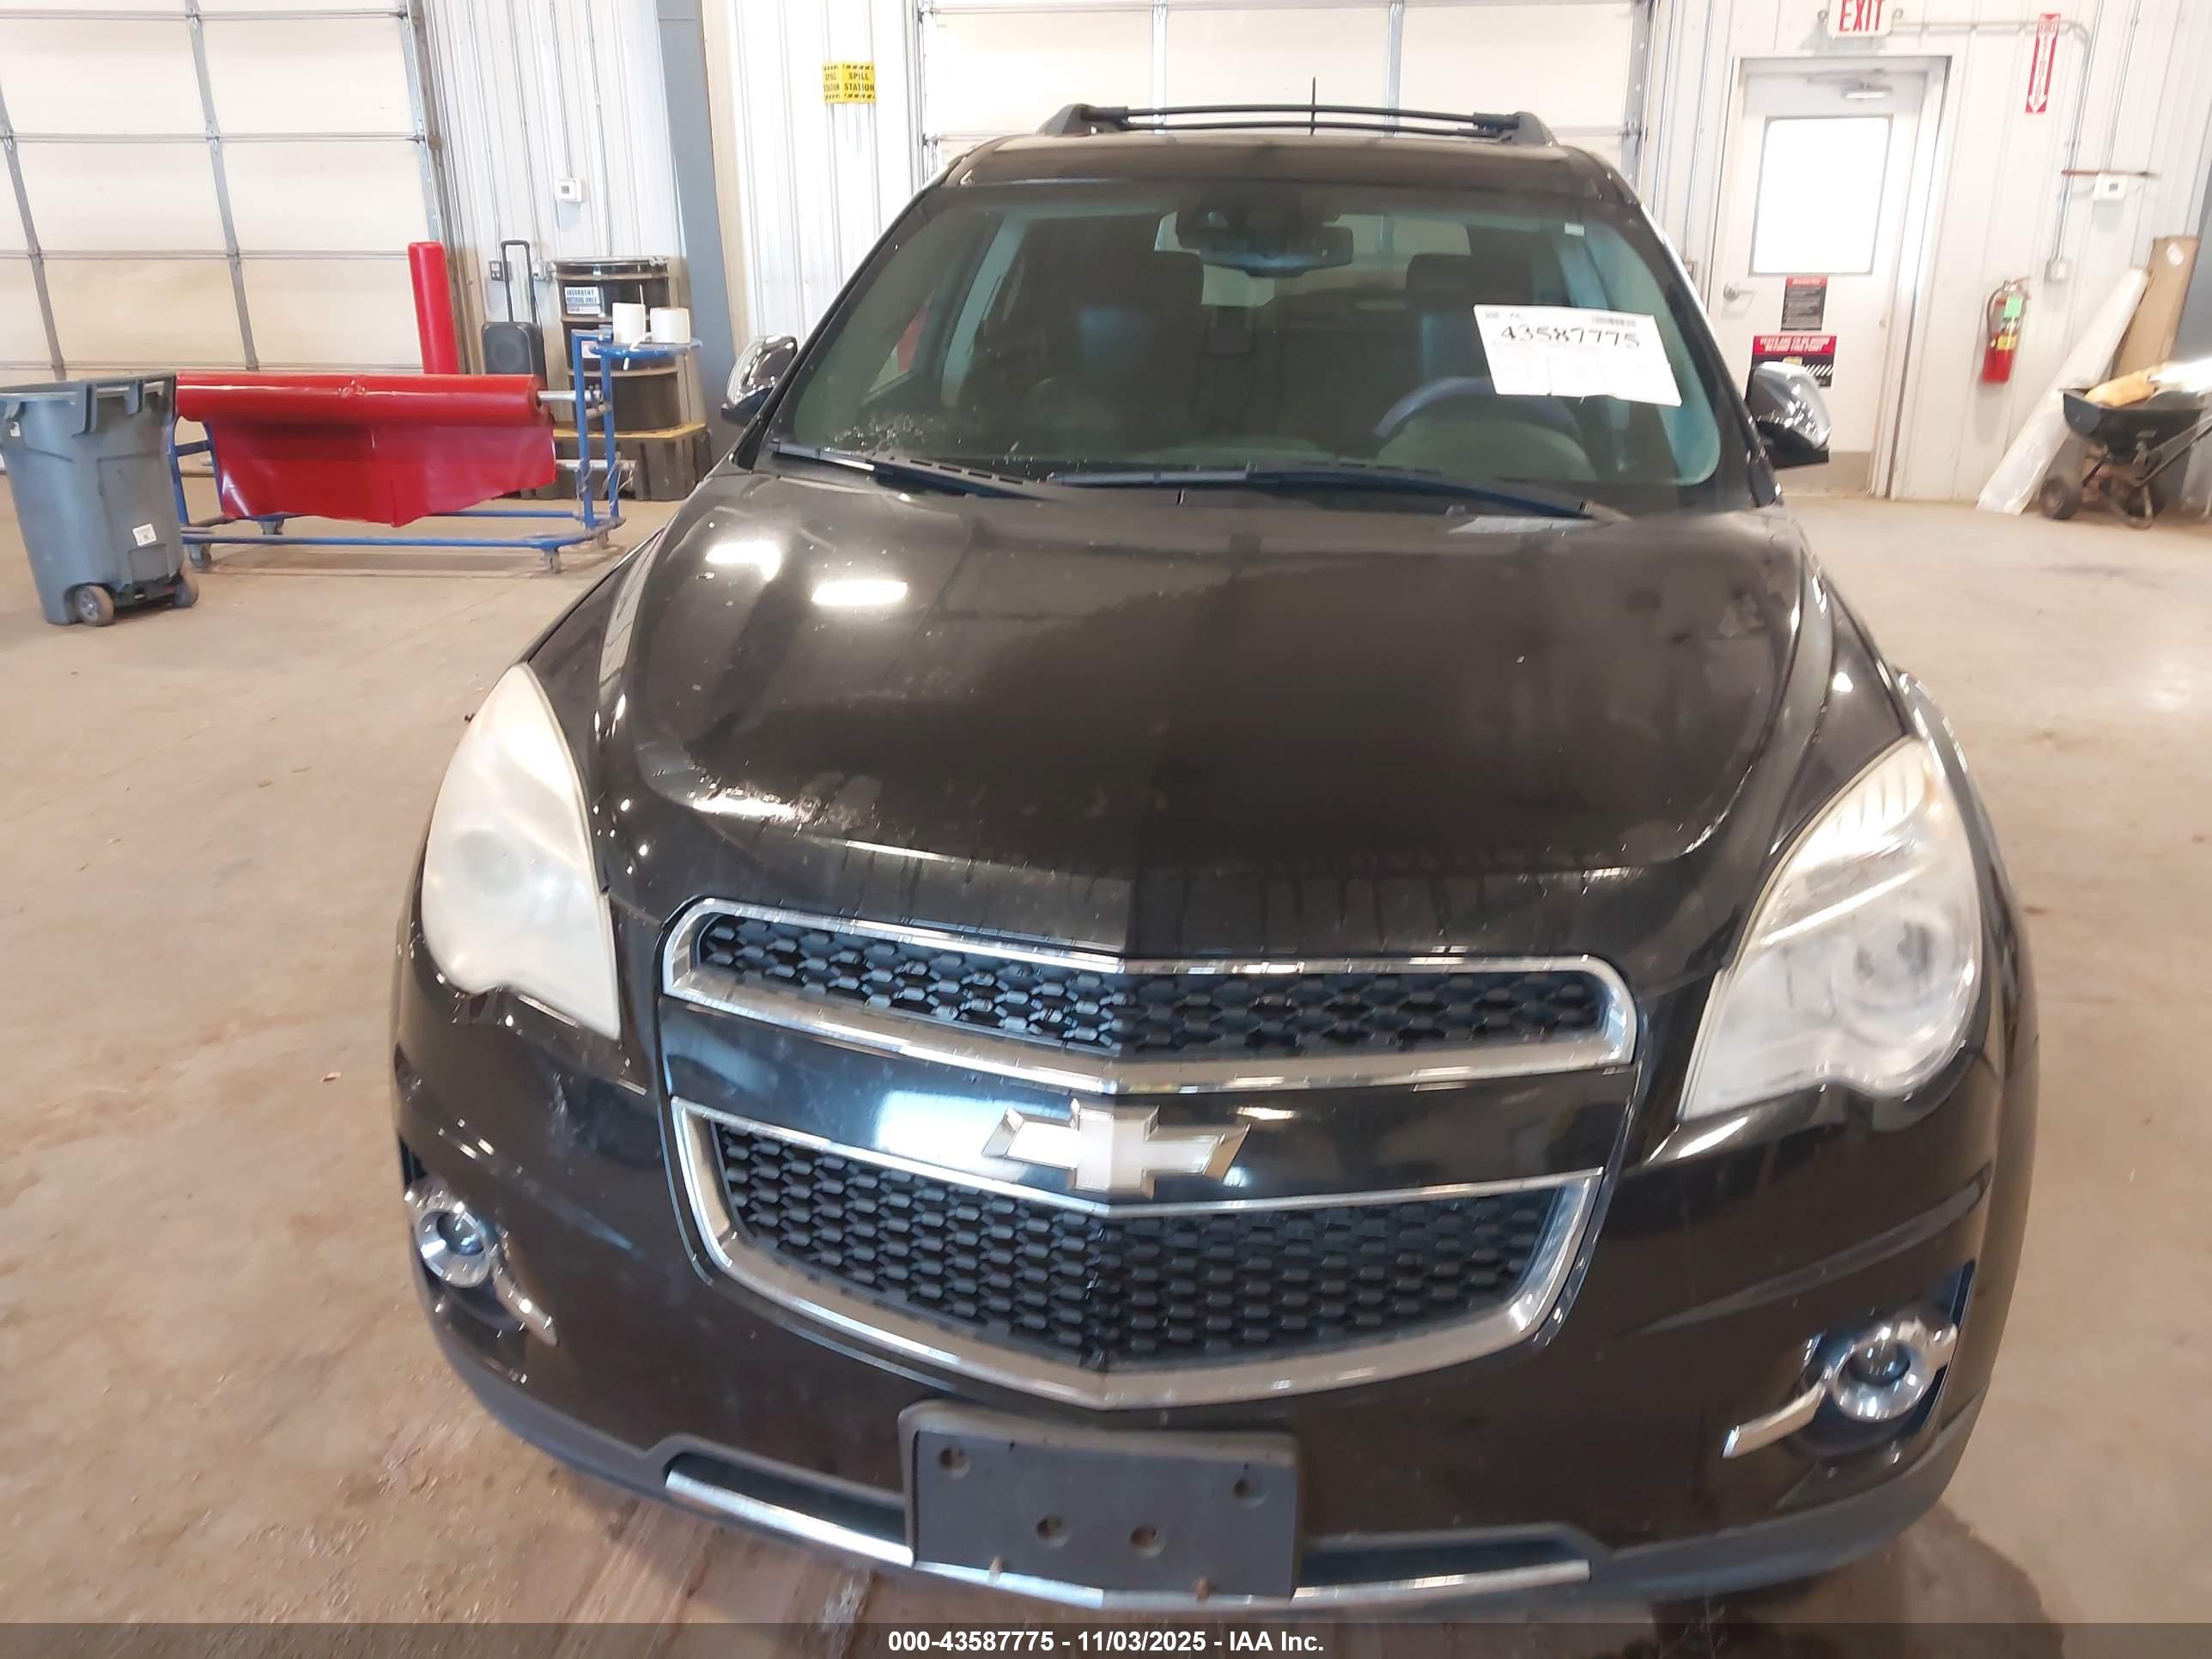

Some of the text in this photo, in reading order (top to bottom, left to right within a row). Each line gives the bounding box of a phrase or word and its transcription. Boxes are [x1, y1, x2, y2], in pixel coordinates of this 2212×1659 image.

[1839, 0, 1886, 31] EXIT
[848, 72, 870, 81] SPILL
[844, 82, 874, 92] STATION
[1501, 325, 1640, 349] 43587775
